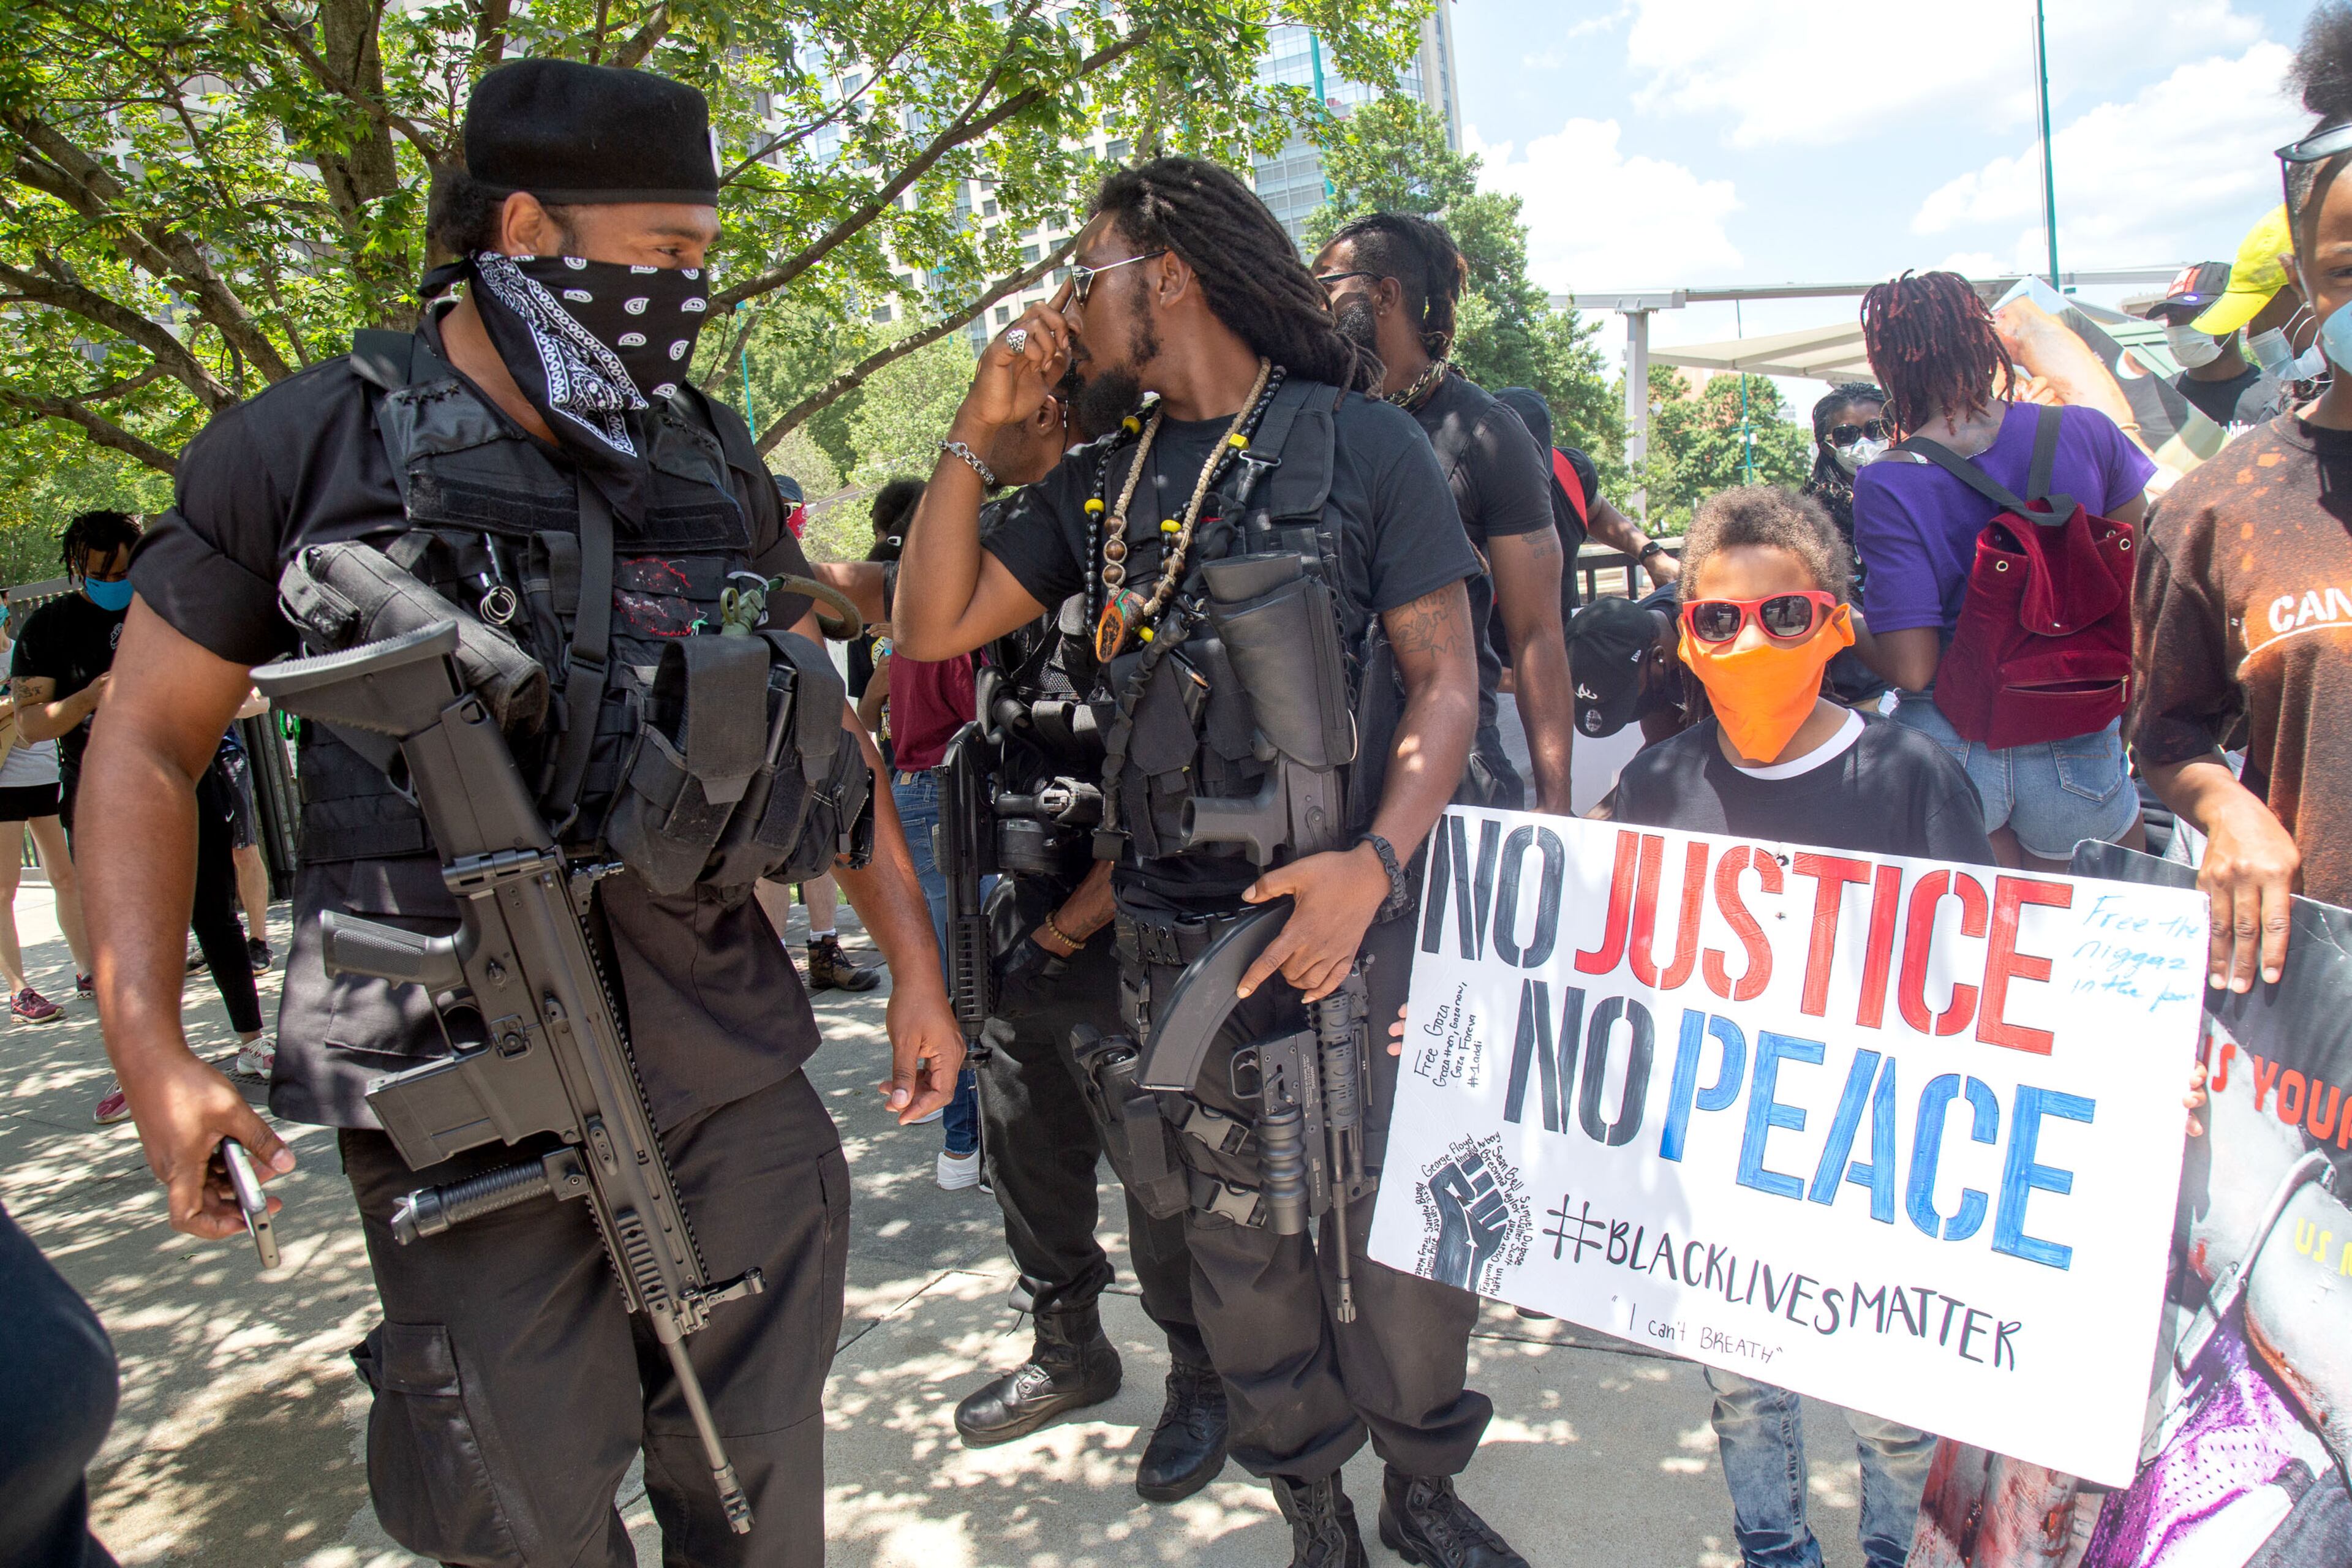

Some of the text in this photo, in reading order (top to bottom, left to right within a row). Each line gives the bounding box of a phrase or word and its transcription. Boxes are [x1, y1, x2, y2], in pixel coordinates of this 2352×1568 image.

[2083, 895, 2150, 932] Free
[1422, 815, 2074, 1056] NO JUSTICE
[1458, 1014, 1476, 1050] Foreva
[1414, 1049, 1438, 1077] Free
[1504, 978, 2096, 1271] NO PEACE
[1421, 1133, 1474, 1177] George Floyd
[1492, 1145, 1525, 1191] Sean Bell
[1480, 1148, 1521, 1214] Breonna Taylor
[1422, 1205, 1434, 1233] Sandra
[1520, 1196, 1534, 1231] Samuel
[1491, 1219, 1517, 1263] Oscar Grant
[1504, 1243, 1520, 1266] Scott
[2295, 1217, 2332, 1262] US
[1479, 1263, 1504, 1296] Trayvon Martin
[1542, 1194, 2022, 1371] #BLACKLIVESMATTER
[1648, 1319, 1686, 1341] can't
